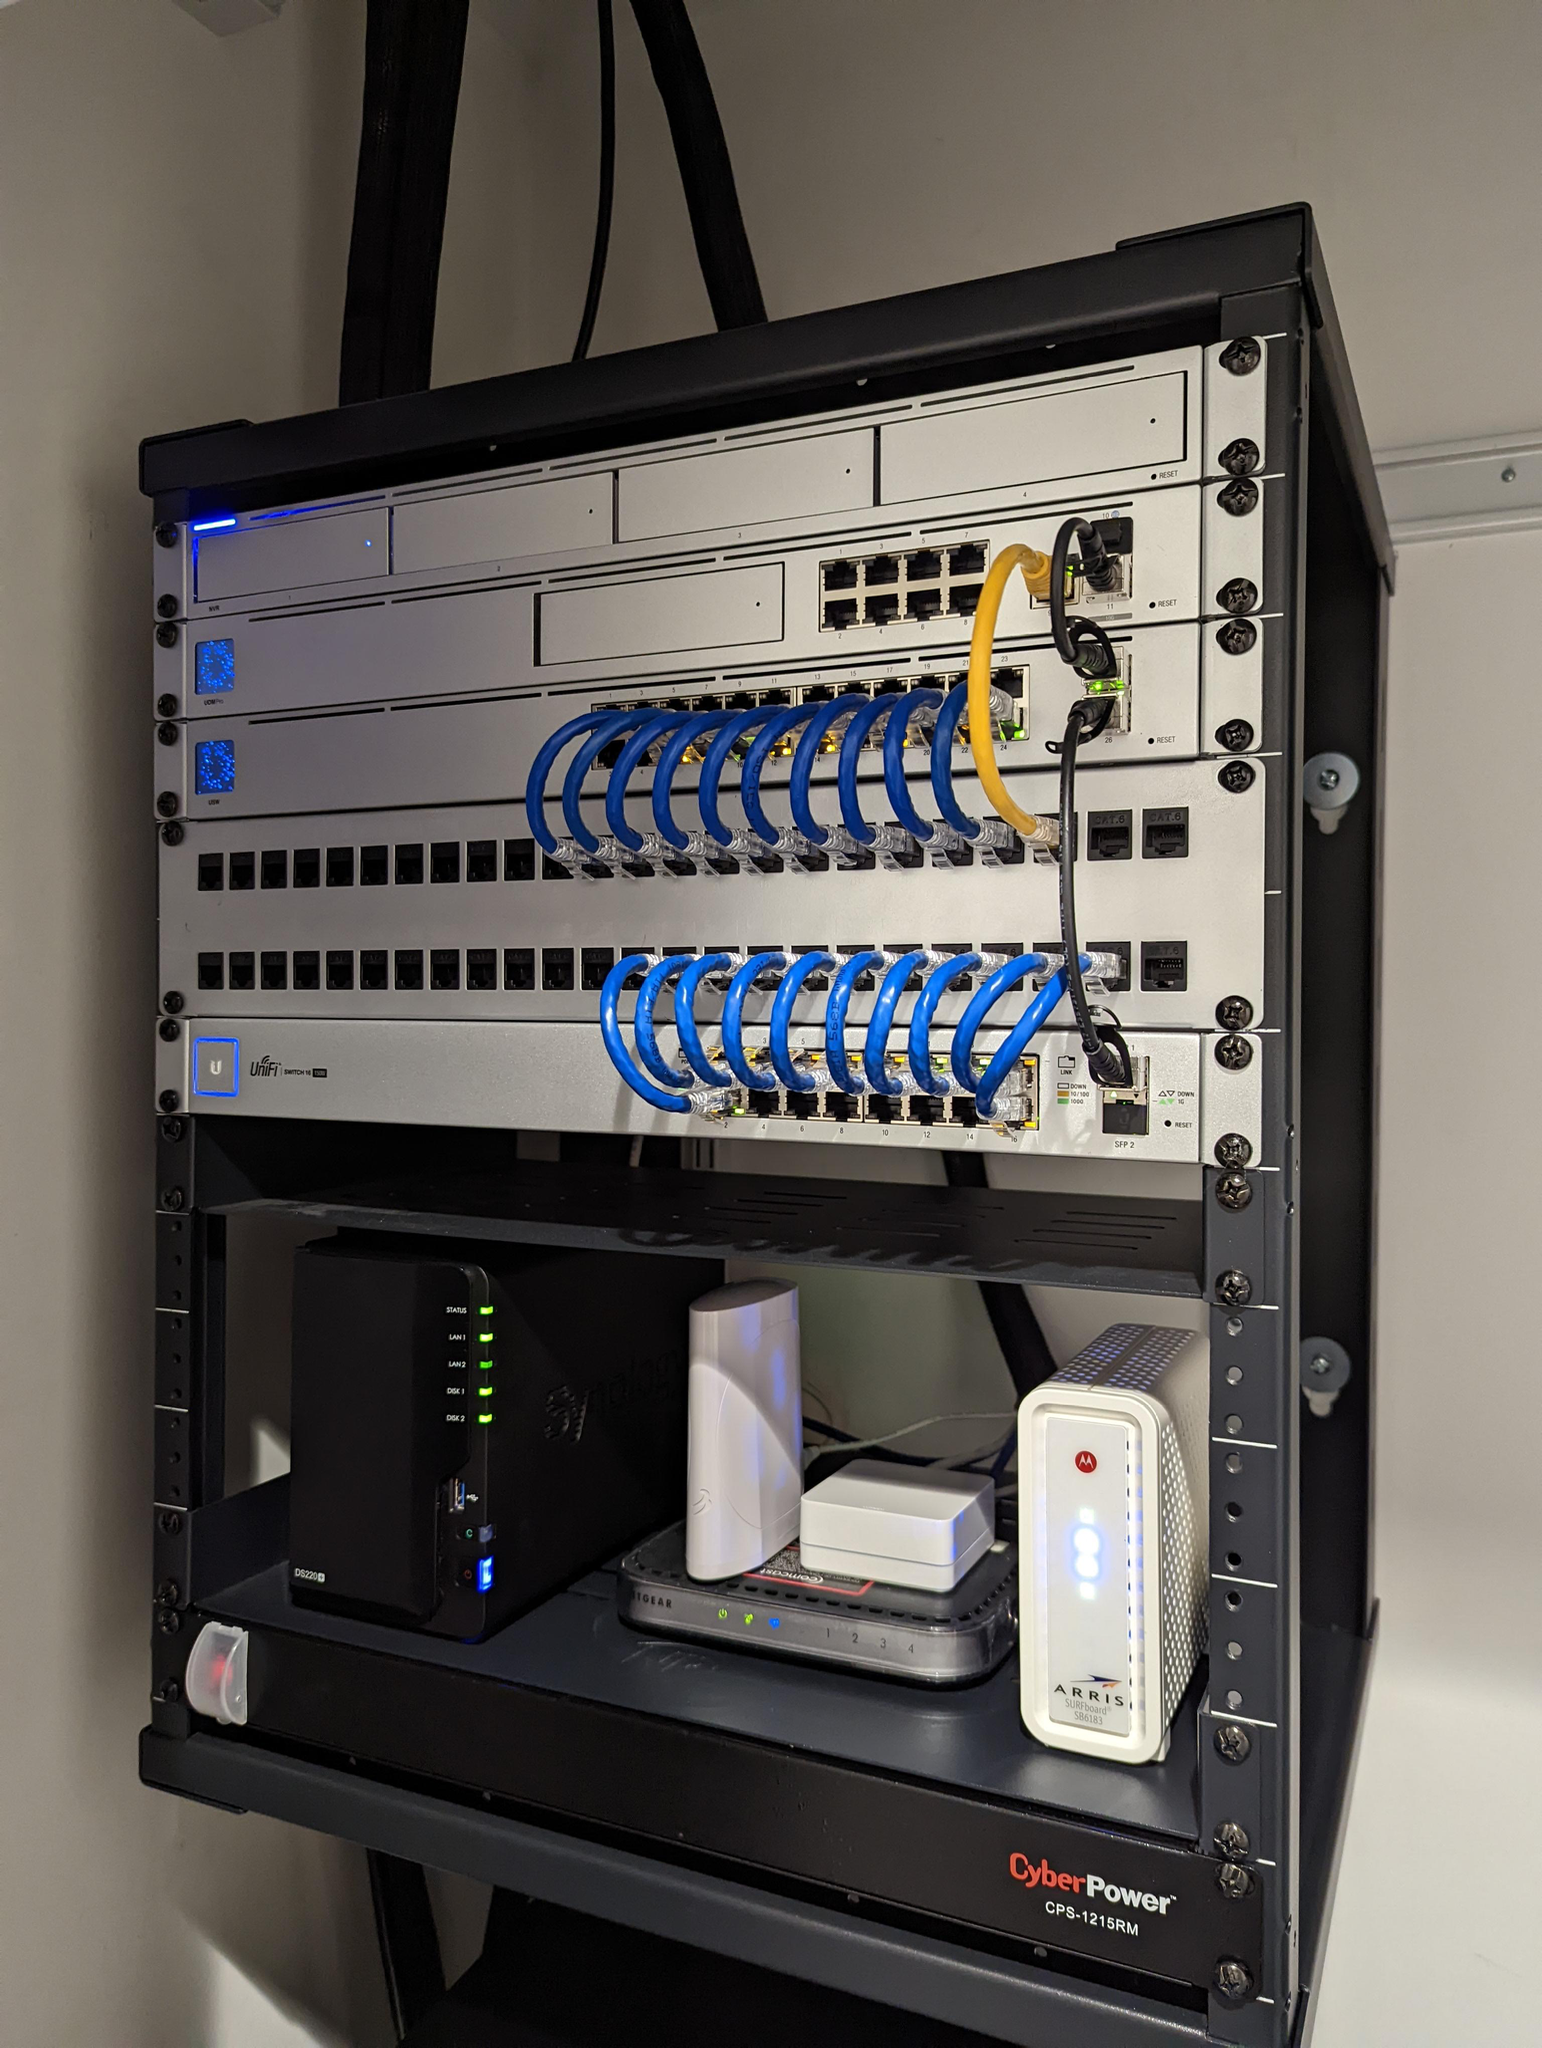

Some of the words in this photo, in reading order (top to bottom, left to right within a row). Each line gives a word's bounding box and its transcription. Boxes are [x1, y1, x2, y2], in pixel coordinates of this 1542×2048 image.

[1158, 470, 1179, 479] RESET
[1158, 599, 1177, 608] RESET
[1156, 736, 1176, 744] RESET
[1095, 815, 1125, 824] CAT.6
[1150, 812, 1181, 822] CAT.6
[446, 1306, 467, 1314] STATUS
[826, 1628, 830, 1638] 1
[852, 1632, 858, 1643] 2
[880, 1638, 886, 1648] 3
[908, 1644, 914, 1653] 4
[1054, 1684, 1124, 1706] ARRIS
[1074, 1710, 1103, 1725] SB6183
[1045, 1901, 1139, 1936] CPS-1215RM
